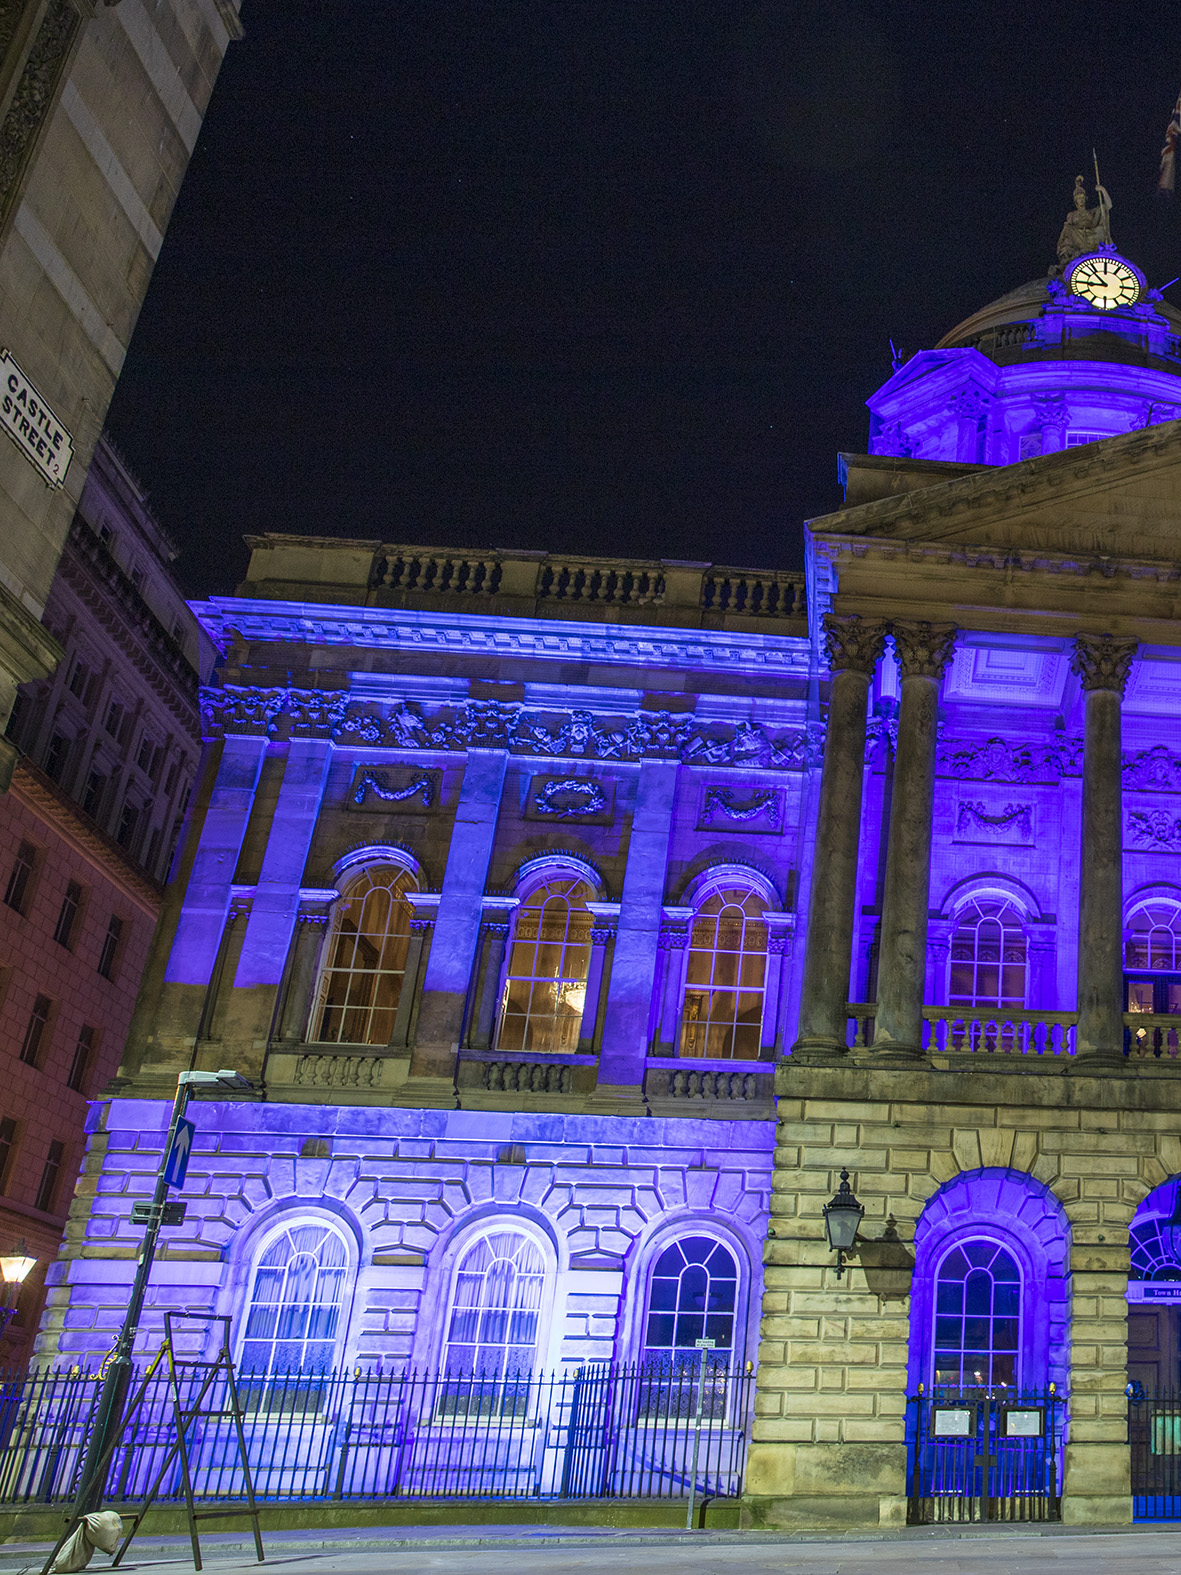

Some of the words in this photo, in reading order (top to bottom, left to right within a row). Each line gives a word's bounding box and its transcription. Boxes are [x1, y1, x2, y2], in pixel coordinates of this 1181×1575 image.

[2, 396, 56, 466] STREET
[7, 373, 64, 451] CASTLE
[52, 463, 60, 475] 2
